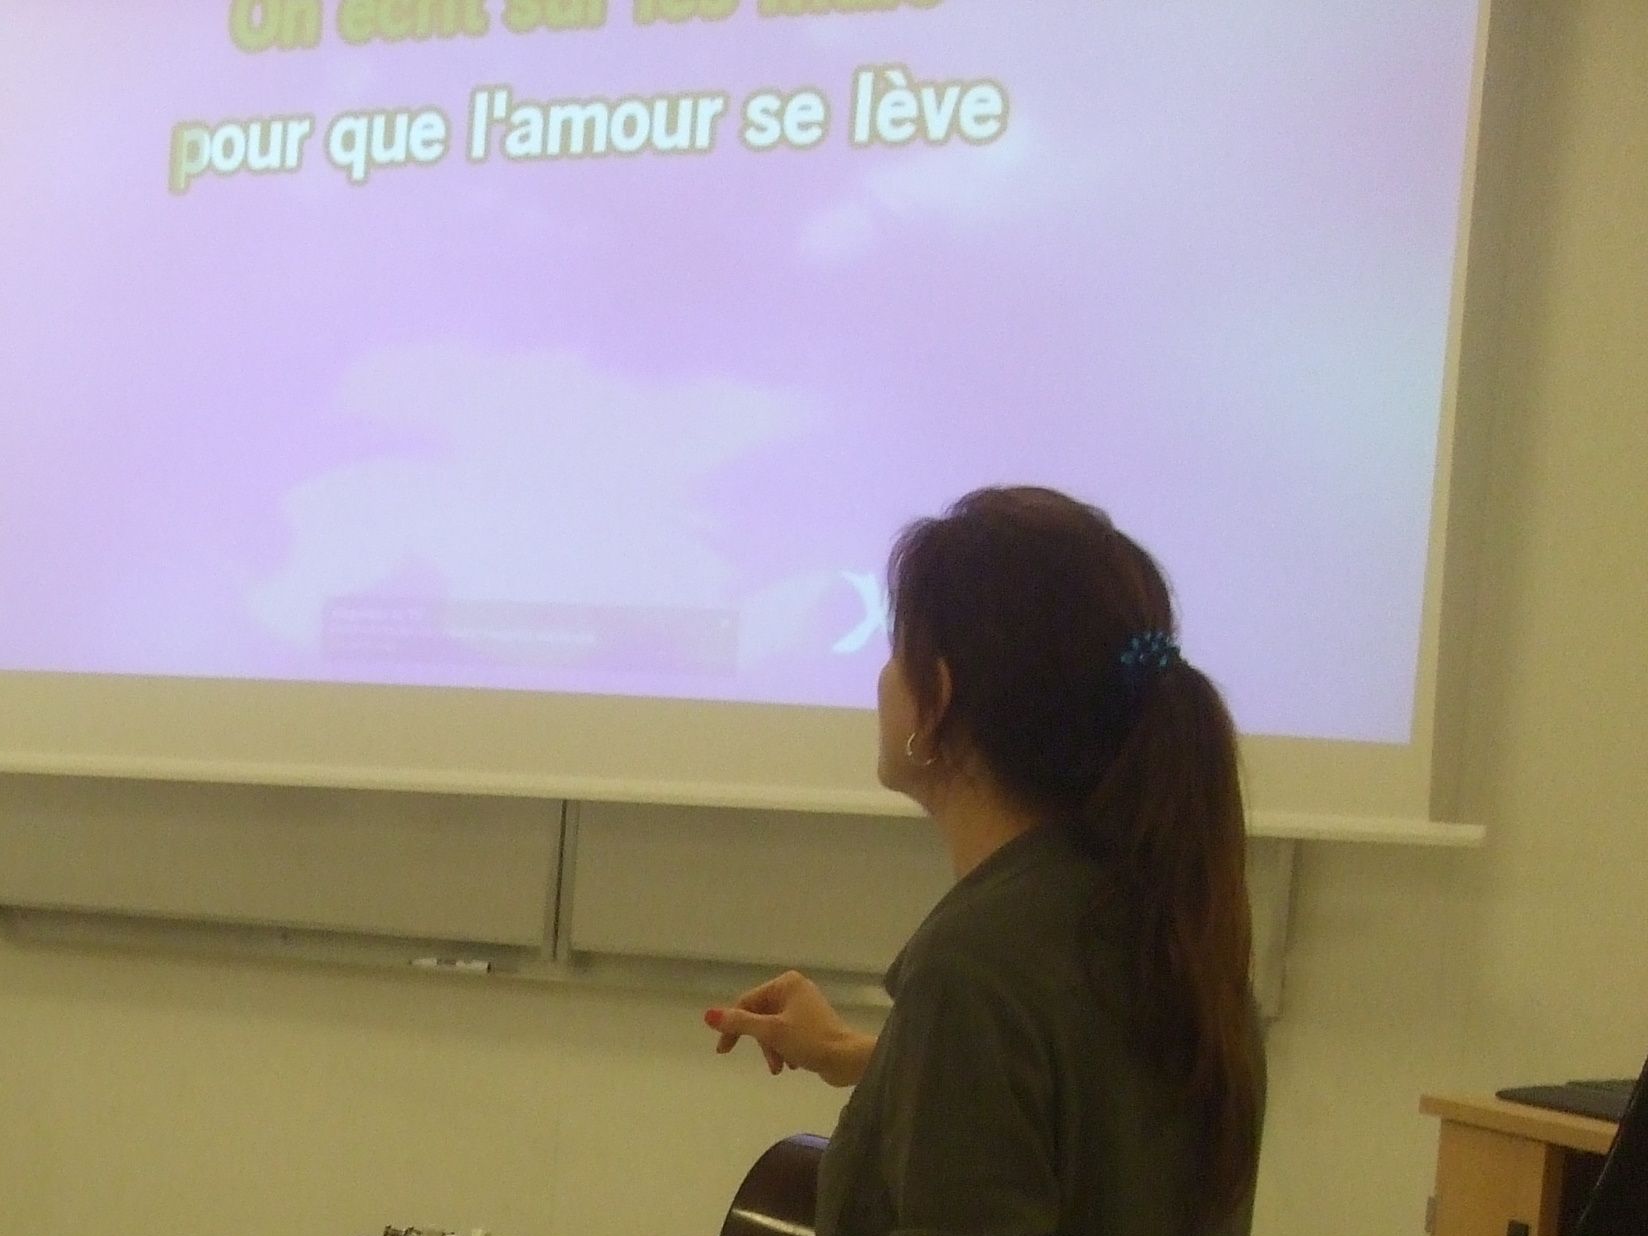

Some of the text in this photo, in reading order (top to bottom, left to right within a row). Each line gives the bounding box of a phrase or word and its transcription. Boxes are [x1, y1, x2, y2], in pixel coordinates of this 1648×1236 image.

[170, 64, 1010, 192] pour que l'amour se lève
